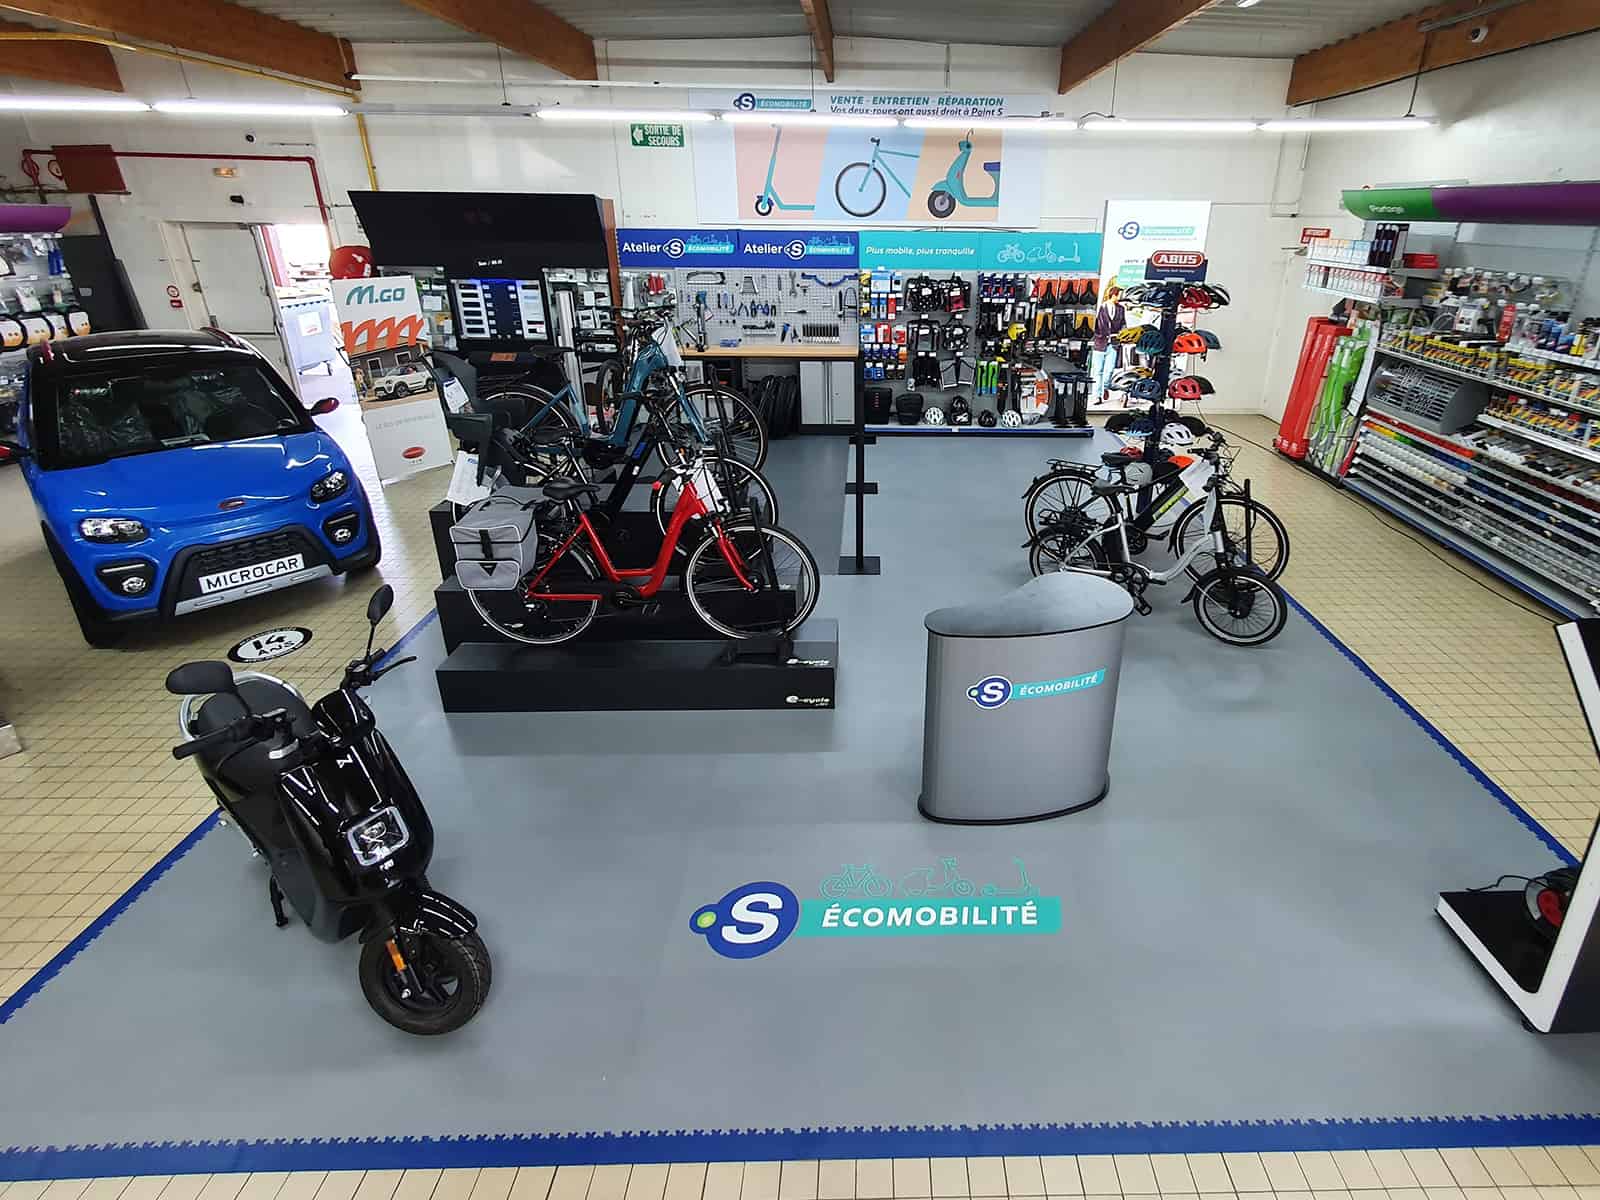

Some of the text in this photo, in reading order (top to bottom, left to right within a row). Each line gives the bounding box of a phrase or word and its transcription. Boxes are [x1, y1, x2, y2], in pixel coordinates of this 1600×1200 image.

[830, 95, 864, 104] VENTE
[872, 96, 929, 105] ENTRETIEN
[937, 95, 1003, 106] RÉPARATION
[915, 107, 939, 116] aussi
[941, 107, 961, 116] droit
[971, 107, 995, 117] Point
[644, 125, 681, 136] SORTIE DE
[647, 136, 680, 146] SECOURS
[622, 242, 662, 255] Atelier
[743, 243, 783, 256] Atelier
[866, 246, 976, 256] Plus mobile, plus tranquille
[1157, 254, 1197, 264] ABUS
[205, 558, 298, 590] MICROCAR
[1019, 672, 1098, 696] ÉCOMOBILITÉ
[721, 893, 1038, 944] S ÉCOMOBILITÉ
